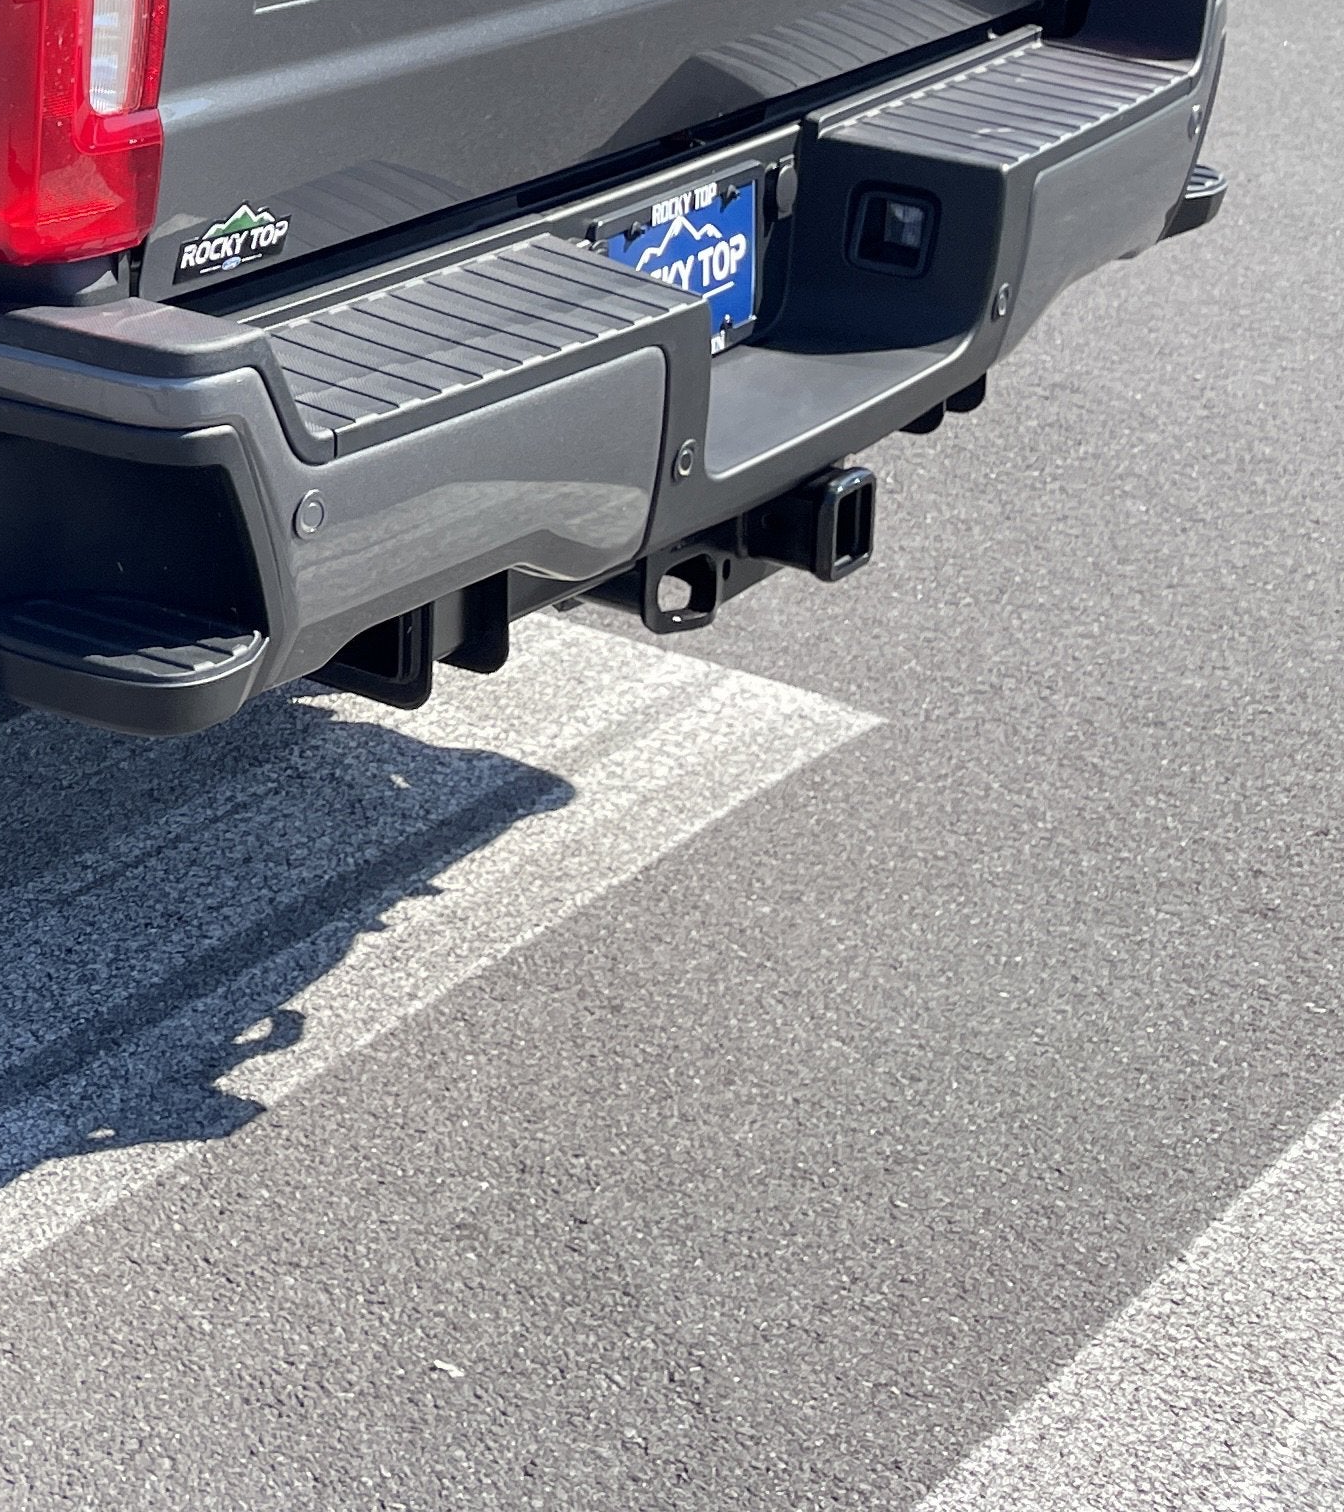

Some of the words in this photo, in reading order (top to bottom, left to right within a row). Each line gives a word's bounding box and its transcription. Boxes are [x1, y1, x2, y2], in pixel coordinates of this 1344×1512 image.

[651, 190, 692, 227] ROCKY
[694, 181, 717, 211] TOP
[180, 230, 249, 269] ROCKY
[250, 219, 289, 250] TOP
[697, 233, 747, 287] TOP
